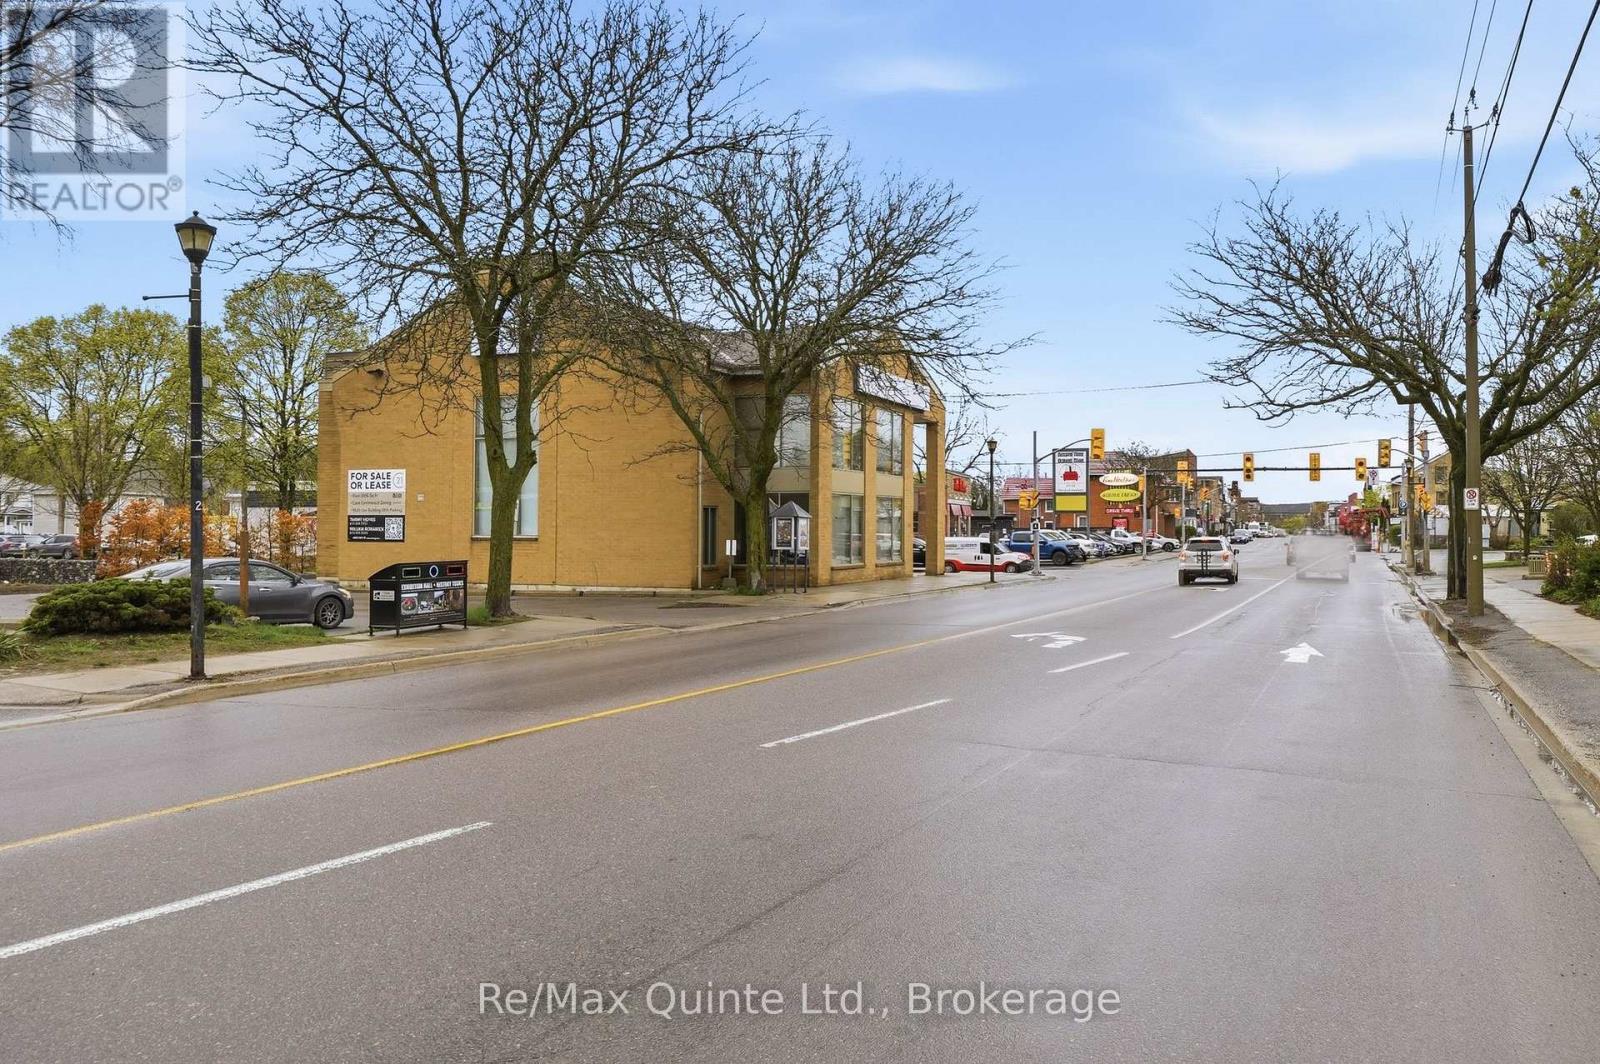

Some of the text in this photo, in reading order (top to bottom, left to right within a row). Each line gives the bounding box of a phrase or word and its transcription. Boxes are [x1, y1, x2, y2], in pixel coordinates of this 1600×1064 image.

[350, 472, 391, 480] FOR SALE
[350, 481, 391, 490] OR LEASE
[195, 500, 202, 511] 2
